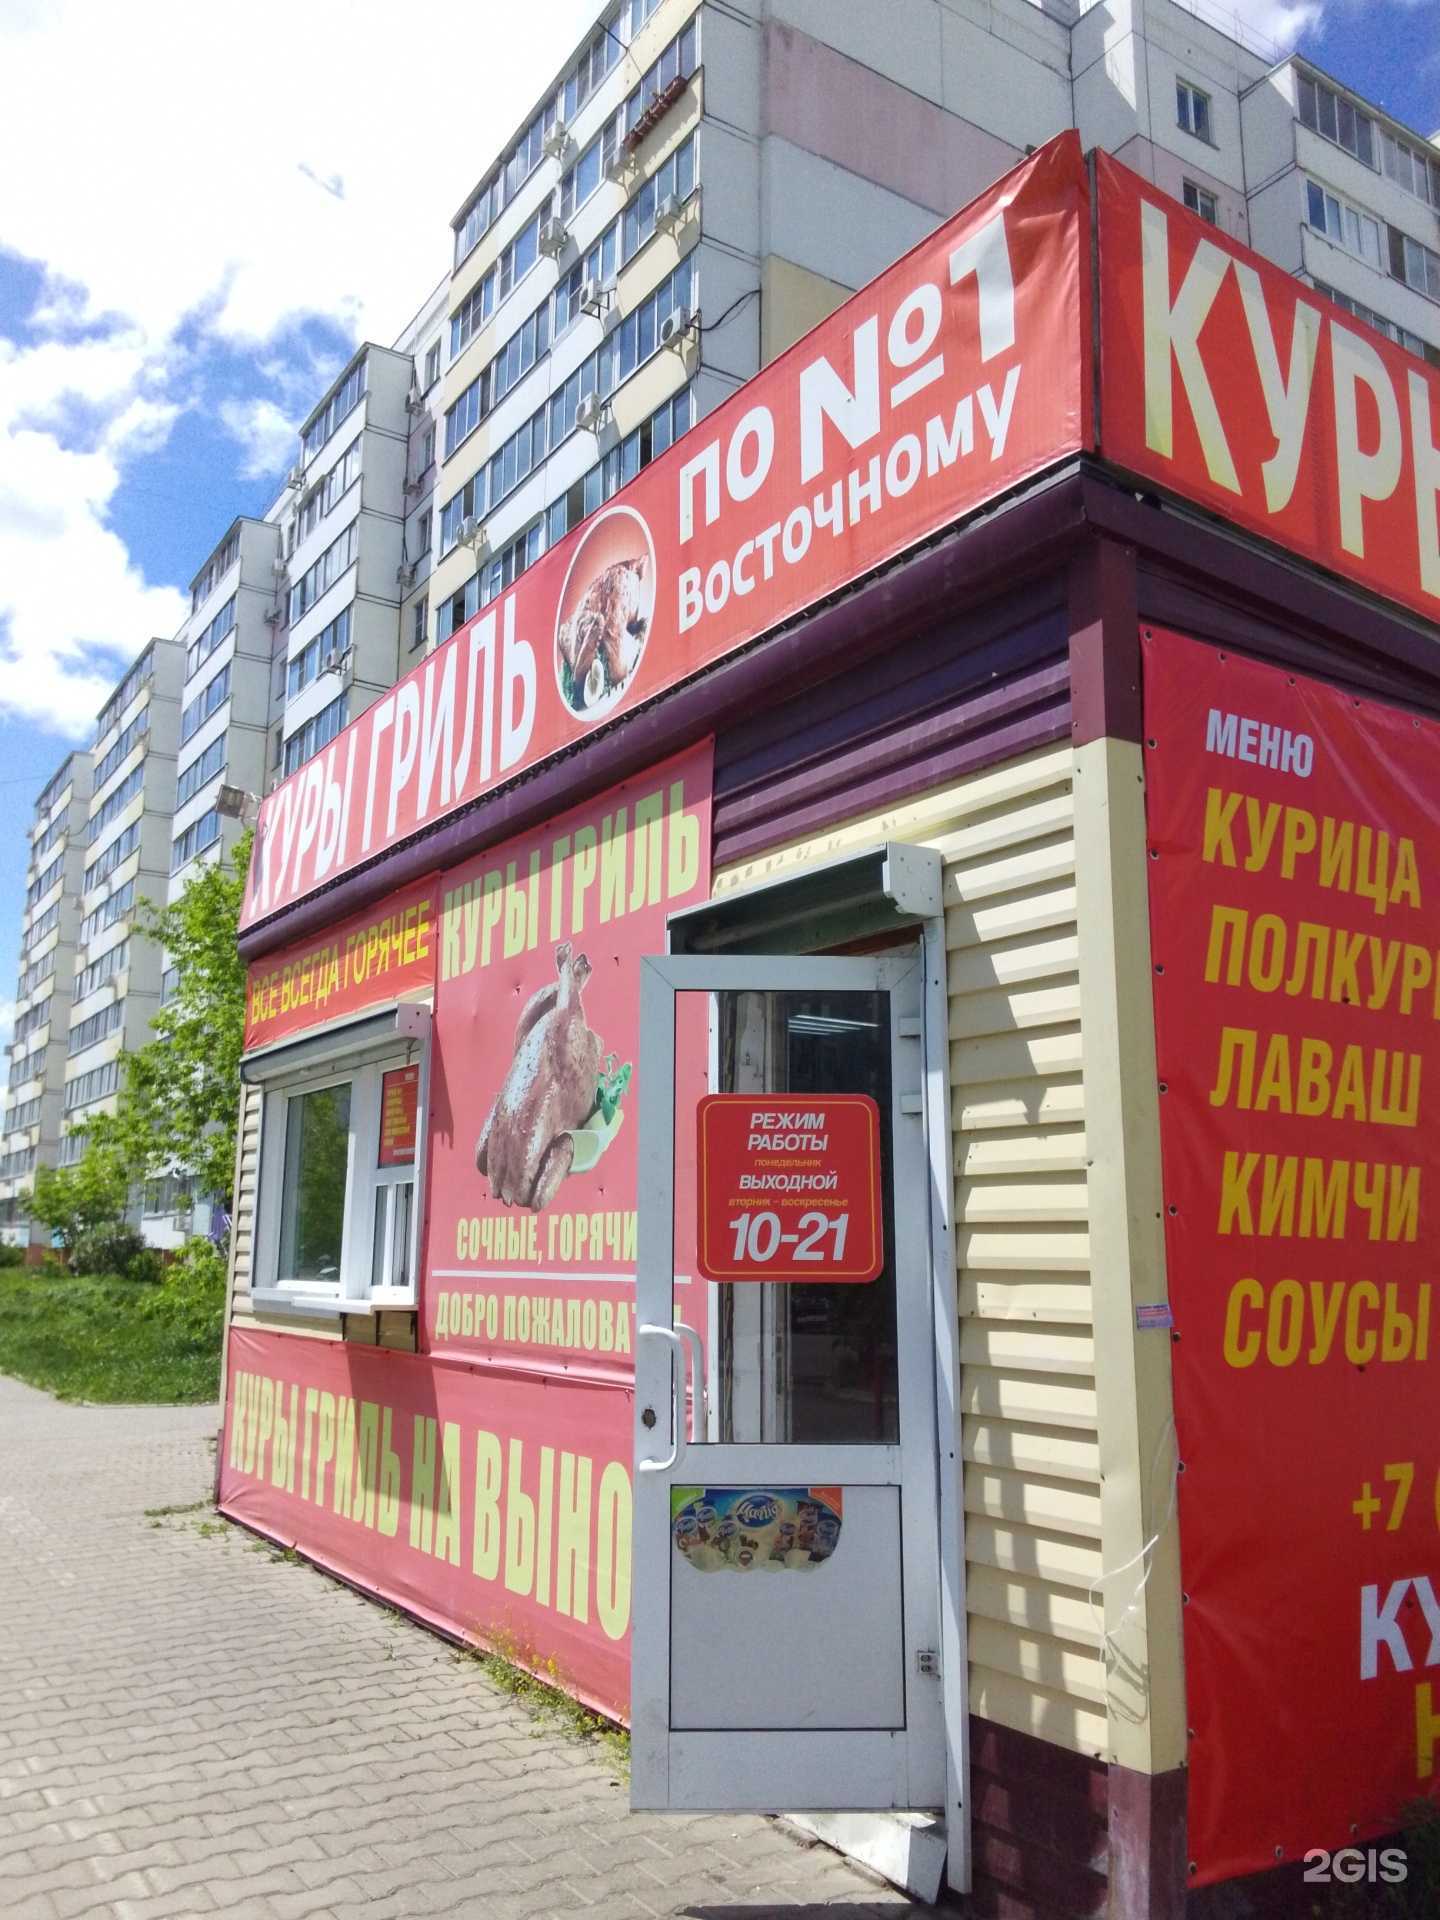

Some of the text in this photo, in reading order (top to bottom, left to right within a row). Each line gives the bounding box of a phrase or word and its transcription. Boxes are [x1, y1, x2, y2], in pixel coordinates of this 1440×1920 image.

[679, 405, 774, 546] ПО
[249, 592, 537, 918] КУРЫ ГРИЛЬ
[1205, 708, 1314, 778] МЕНЮ
[442, 780, 700, 982] КУРЫ ГРИЛЬ
[1202, 787, 1422, 915] КУРИЦА
[252, 900, 430, 1026] ВСЕ ВСЕГДА ГОРЯЧЕЕ
[1204, 904, 1440, 1020] ПОЛКУР
[1209, 1026, 1422, 1127] ЛАВАШ
[747, 1134, 828, 1151] РАБОТЫ
[751, 1112, 826, 1130] РЕЖИМ
[728, 1198, 771, 1209] вторник
[781, 1198, 849, 1209] воскресенье
[739, 1170, 838, 1192] ВЫХОДНОЙ
[754, 1159, 822, 1168] понедельник
[1217, 1151, 1421, 1242] КИМЧИ
[456, 1215, 543, 1265] СОЧНЫЕ,
[729, 1211, 849, 1262] 10-21
[435, 1292, 638, 1354] ДОБРО ПОЖАЛОВА
[1223, 1278, 1432, 1368] СОУСЫ
[230, 1370, 633, 1642] КУРЫ ГРИЛЬ НА ВЫНО
[1352, 1462, 1415, 1531] +7
